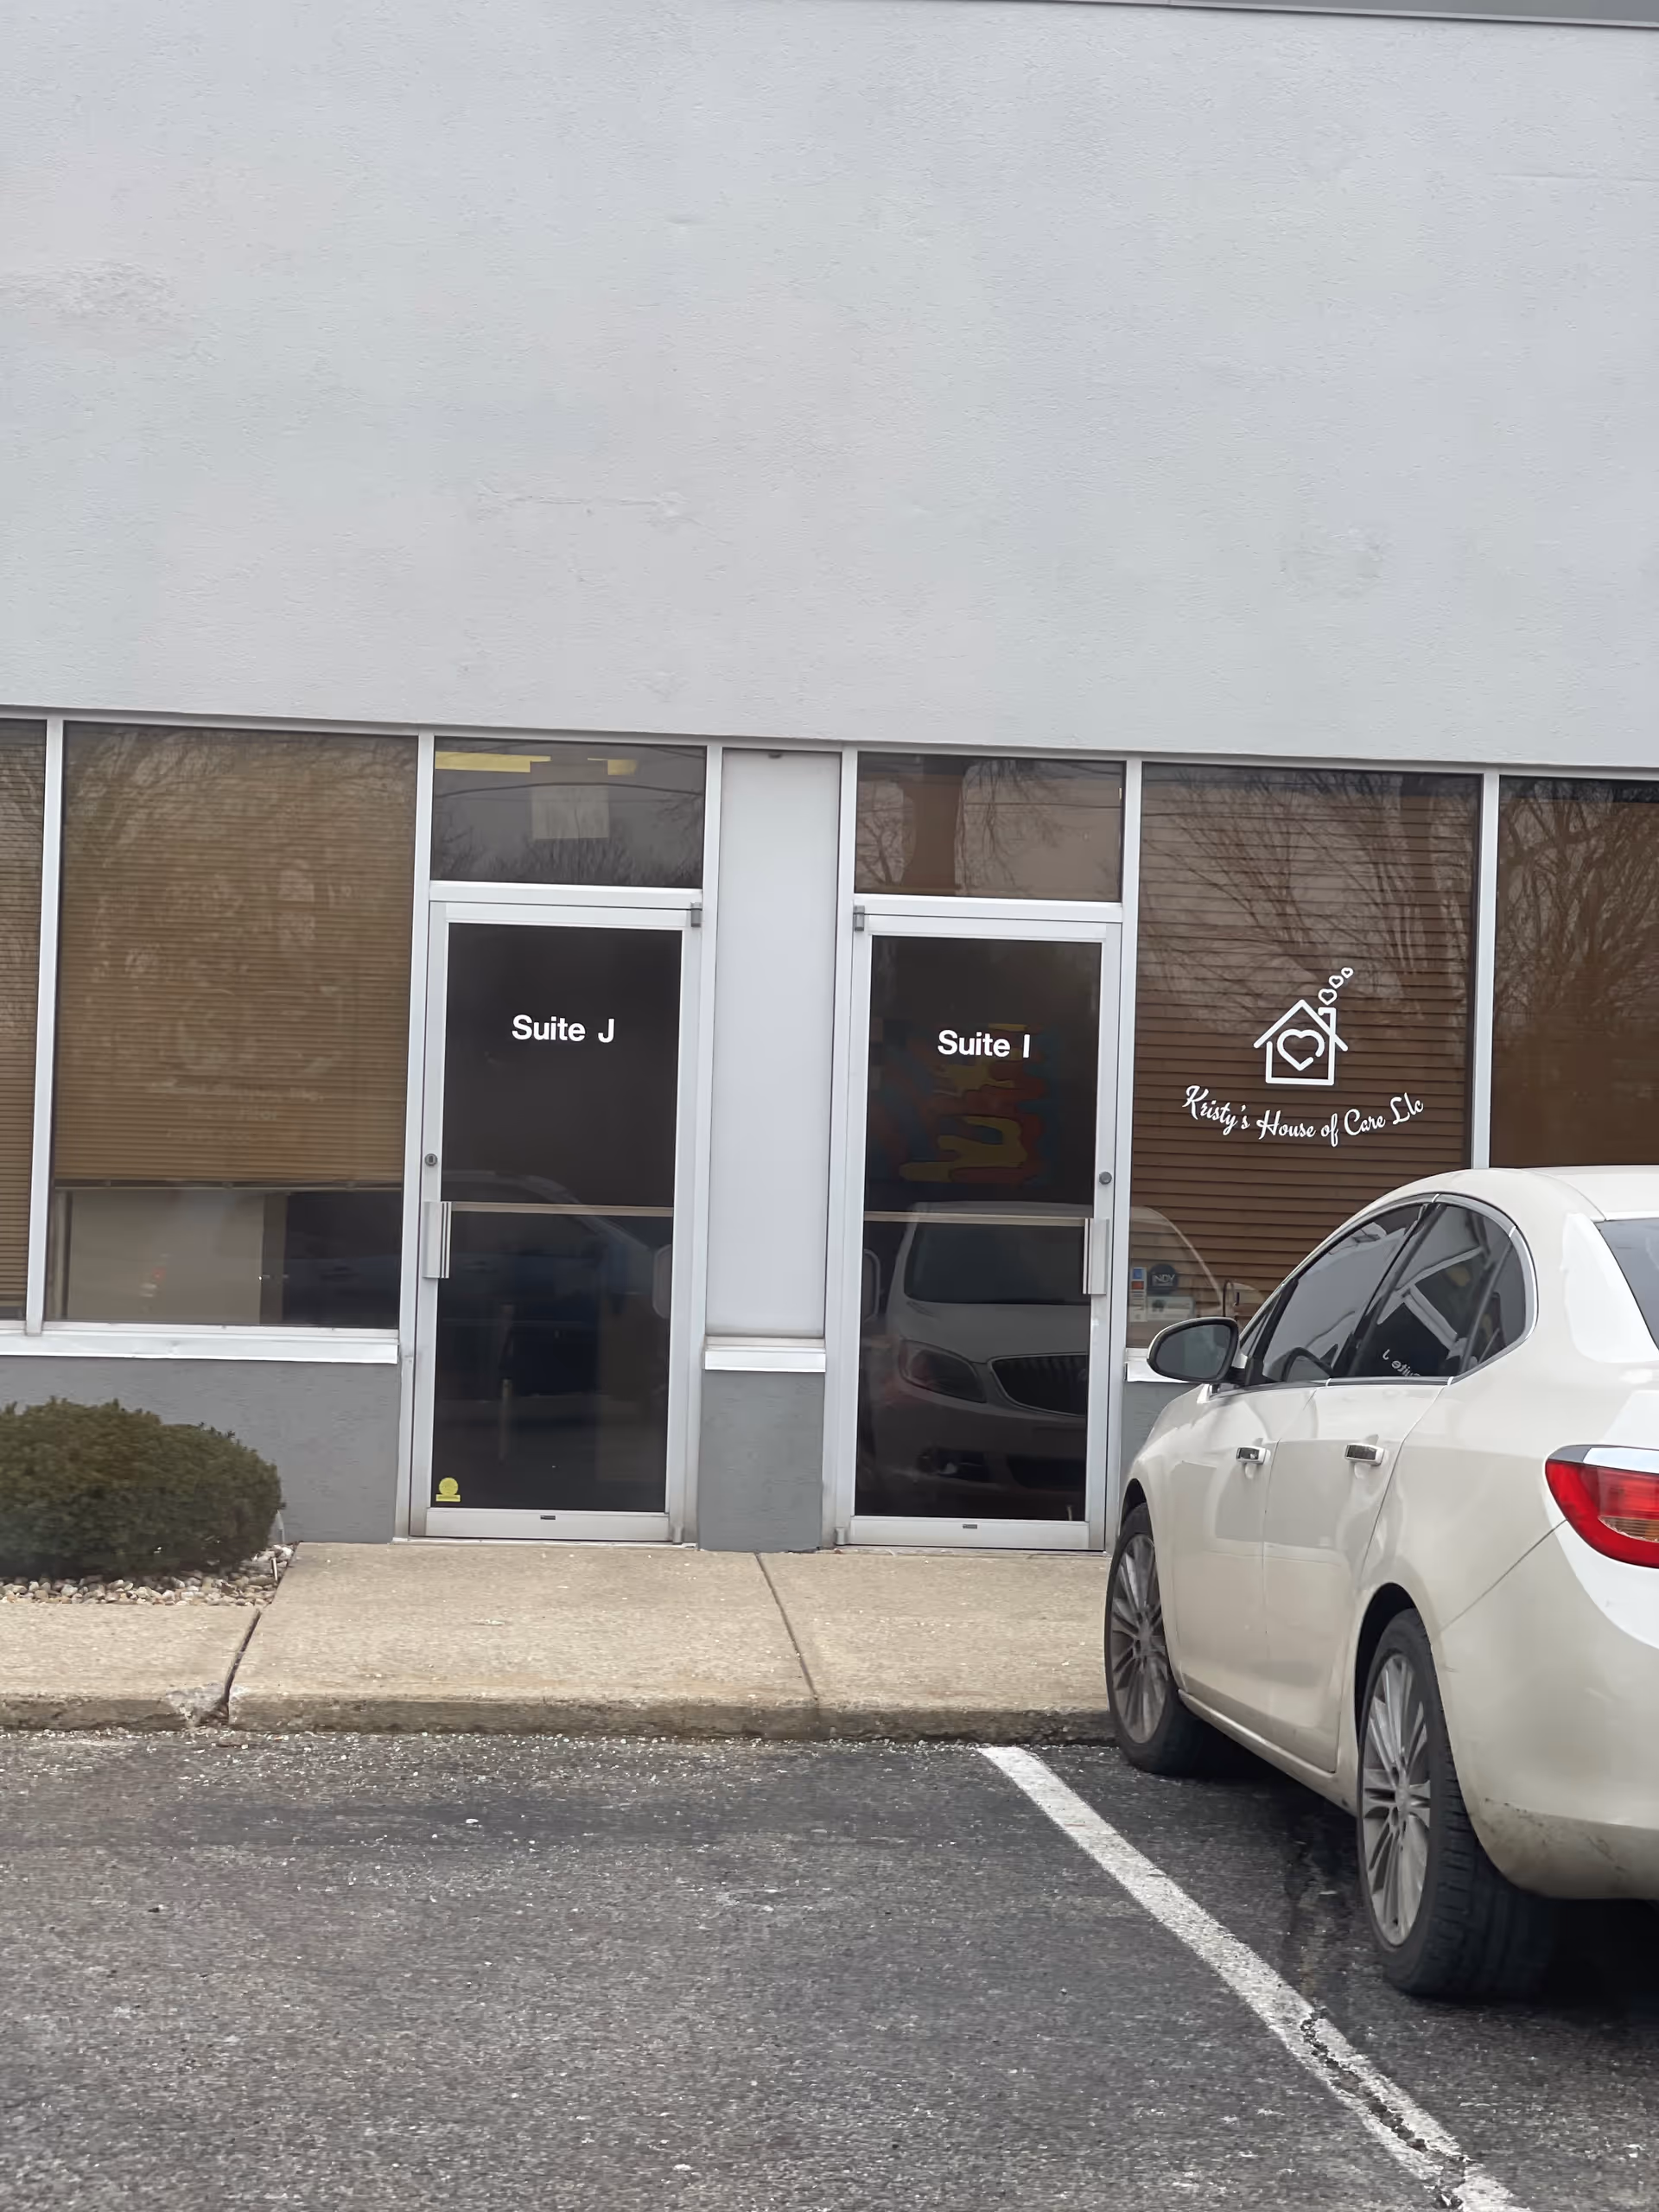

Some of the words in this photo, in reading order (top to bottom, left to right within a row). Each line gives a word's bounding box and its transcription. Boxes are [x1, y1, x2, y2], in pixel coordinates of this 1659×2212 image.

[512, 1014, 586, 1042] Suite
[597, 1018, 615, 1043] J
[938, 1029, 1011, 1058] Suite
[1022, 1033, 1031, 1058] I
[1182, 1085, 1250, 1135] Kristy's
[1256, 1109, 1317, 1140] House
[1320, 1113, 1339, 1147] of
[1344, 1109, 1386, 1136] Care
[1389, 1092, 1424, 1124] Llc
